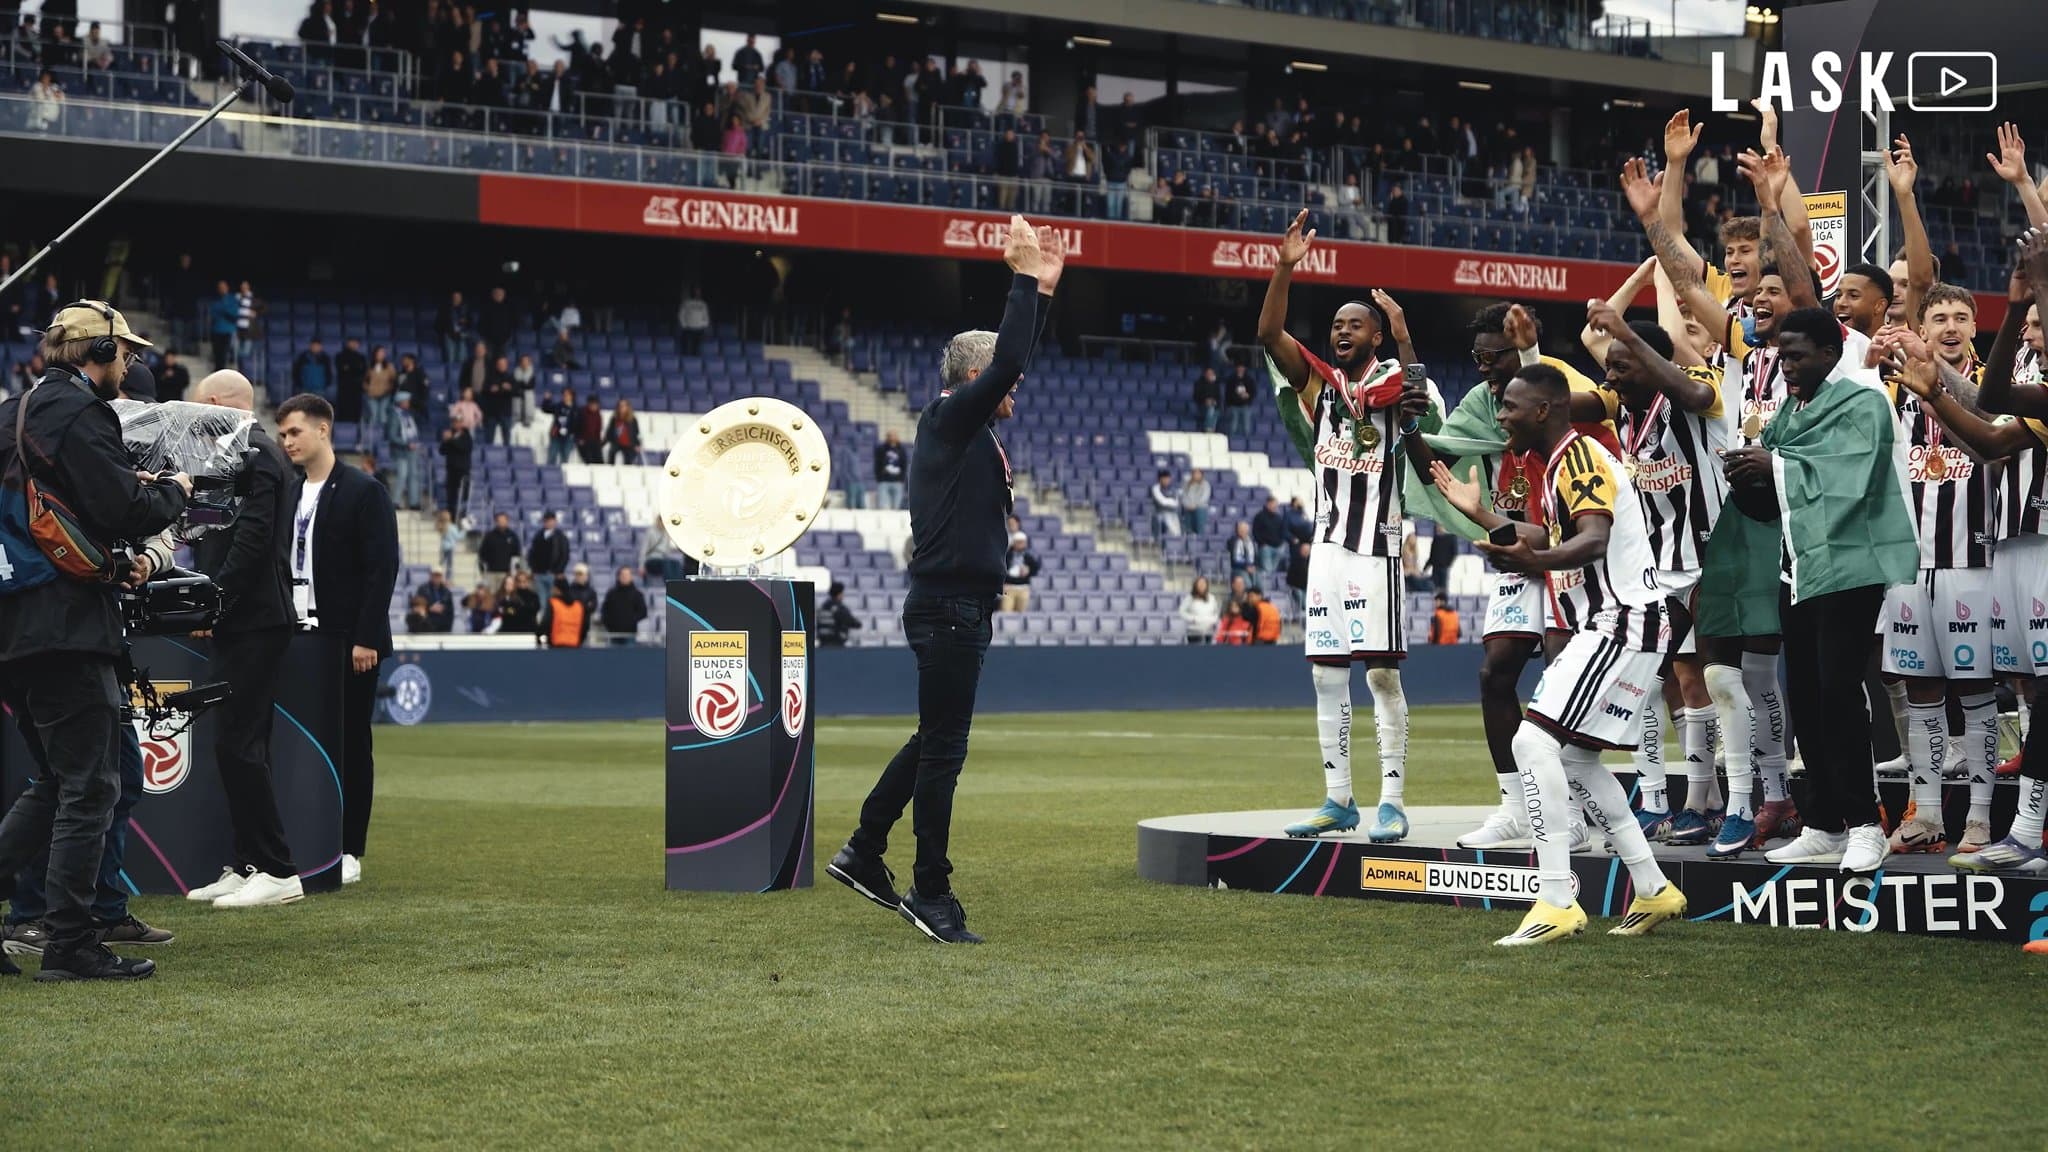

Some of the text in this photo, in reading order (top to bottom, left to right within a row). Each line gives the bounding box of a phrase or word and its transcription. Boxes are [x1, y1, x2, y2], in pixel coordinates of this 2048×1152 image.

[1806, 200, 1843, 212] DMIRAL
[681, 198, 799, 235] GENERALI
[1810, 219, 1843, 231] UNDES
[1813, 231, 1834, 241] IGA
[1242, 243, 1338, 274] GENRALI
[1482, 261, 1567, 292] GENERALI
[1315, 445, 1384, 474] Kornspitz
[1499, 583, 1525, 596] BWT
[1344, 599, 1368, 610] BWT
[1893, 622, 1919, 635] BWT
[1948, 622, 1978, 633] BWT
[1992, 618, 2006, 630] WT
[694, 640, 743, 649] ADMIRAL
[783, 640, 804, 649] ADMIRAL
[694, 659, 743, 669] BUNDES
[783, 659, 804, 669] BUNDES
[704, 670, 732, 679] LIGA
[1605, 703, 1634, 721] BWT
[143, 722, 172, 732] LGA
[1365, 867, 1540, 894] ADMIRAL BUNDESLIG
[1731, 874, 2008, 933] MEISTER
